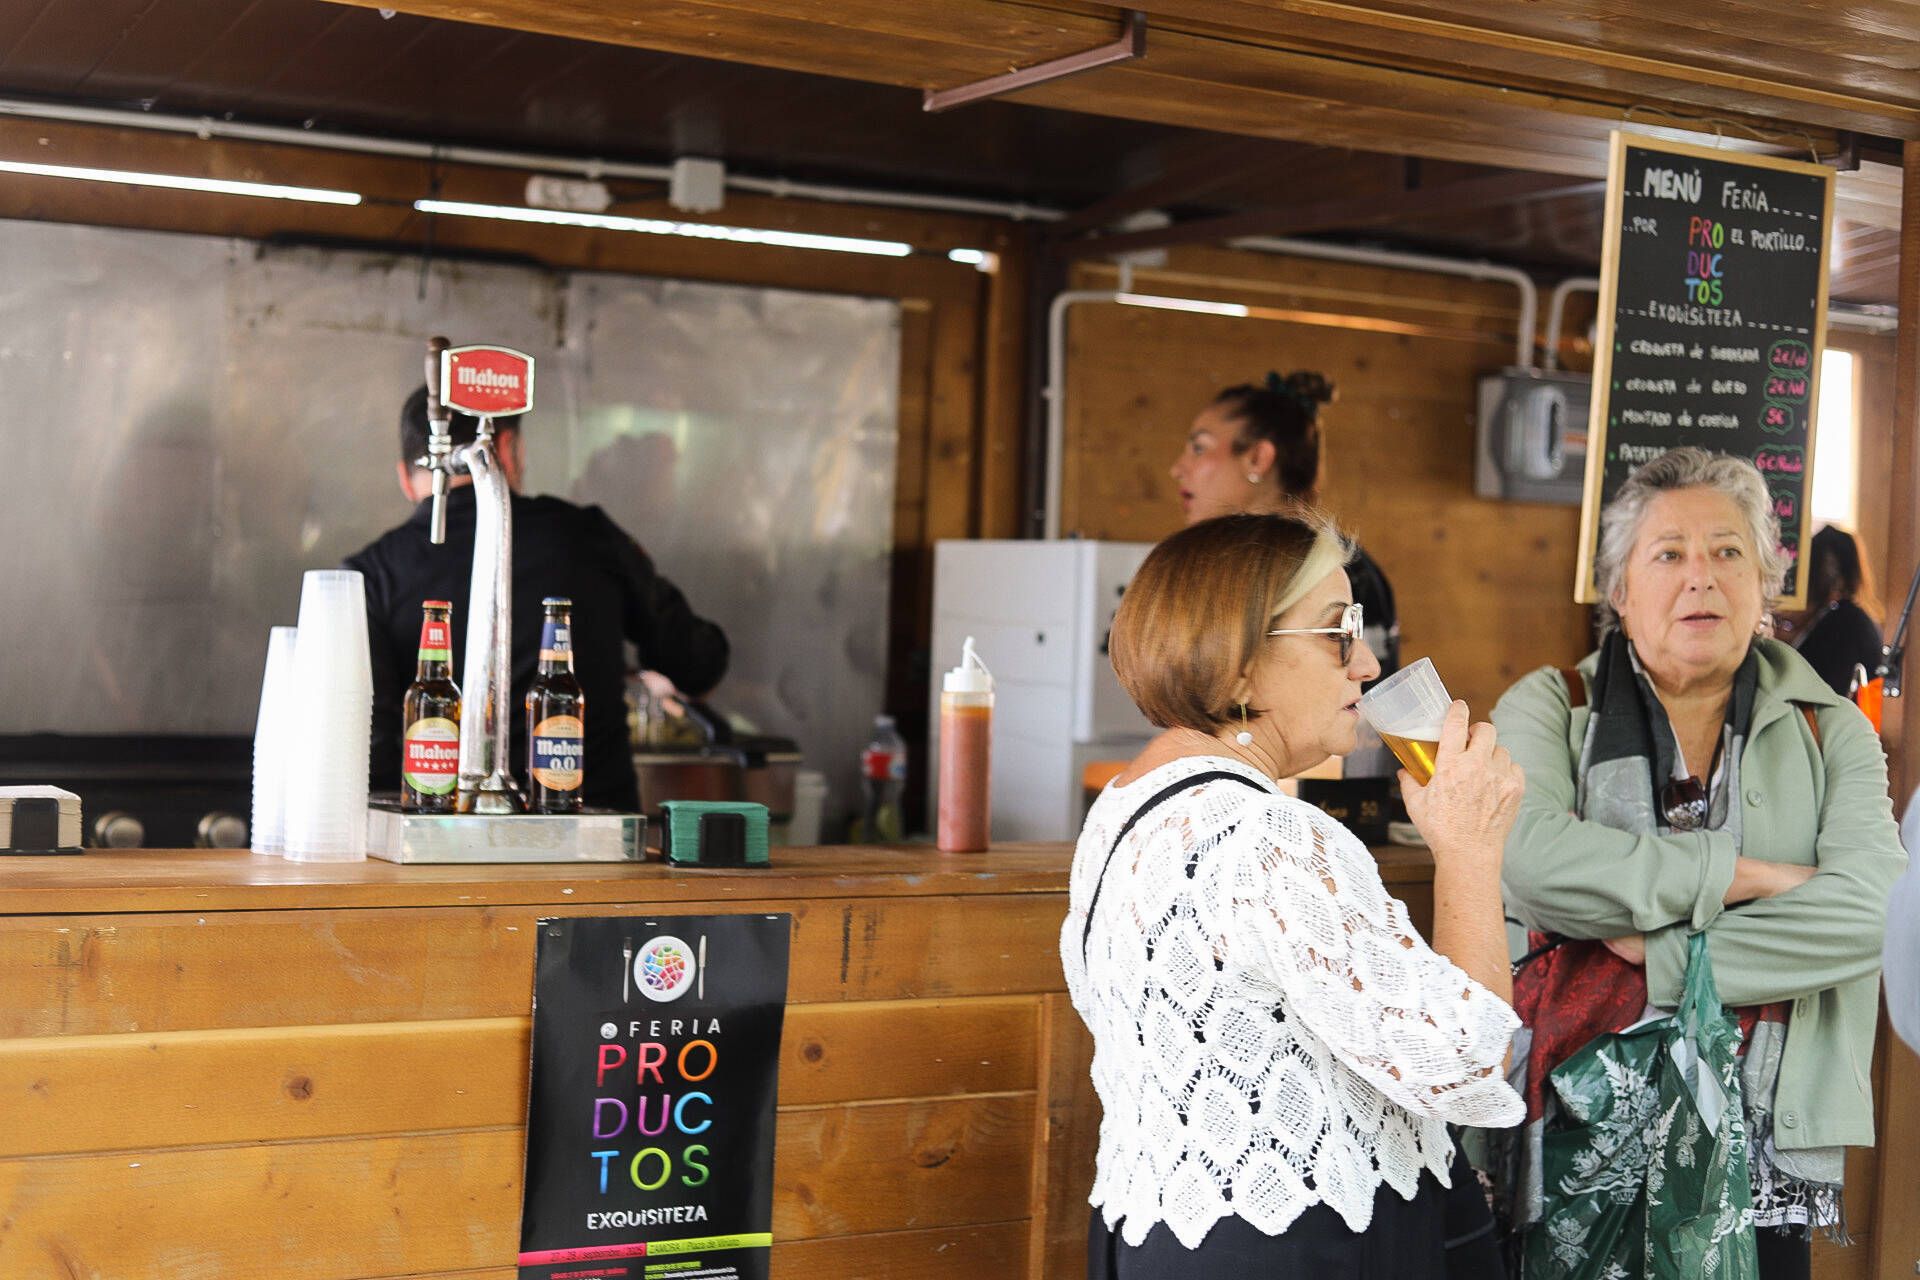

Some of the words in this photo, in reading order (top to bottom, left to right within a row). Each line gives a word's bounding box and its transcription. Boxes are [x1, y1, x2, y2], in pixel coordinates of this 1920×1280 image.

[1632, 216, 1658, 237] POR
[1688, 216, 1724, 249] PRO
[1730, 228, 1745, 246] EL
[1687, 250, 1724, 279] DUC
[1684, 277, 1724, 306] TOS
[1690, 342, 1704, 360] de
[457, 366, 520, 389] Mahou
[1686, 378, 1702, 394] de
[1677, 409, 1693, 427] de
[629, 1018, 721, 1038] FERIA
[596, 1039, 718, 1088] PRO
[592, 1091, 714, 1140] DUC
[591, 1143, 710, 1195] TOS
